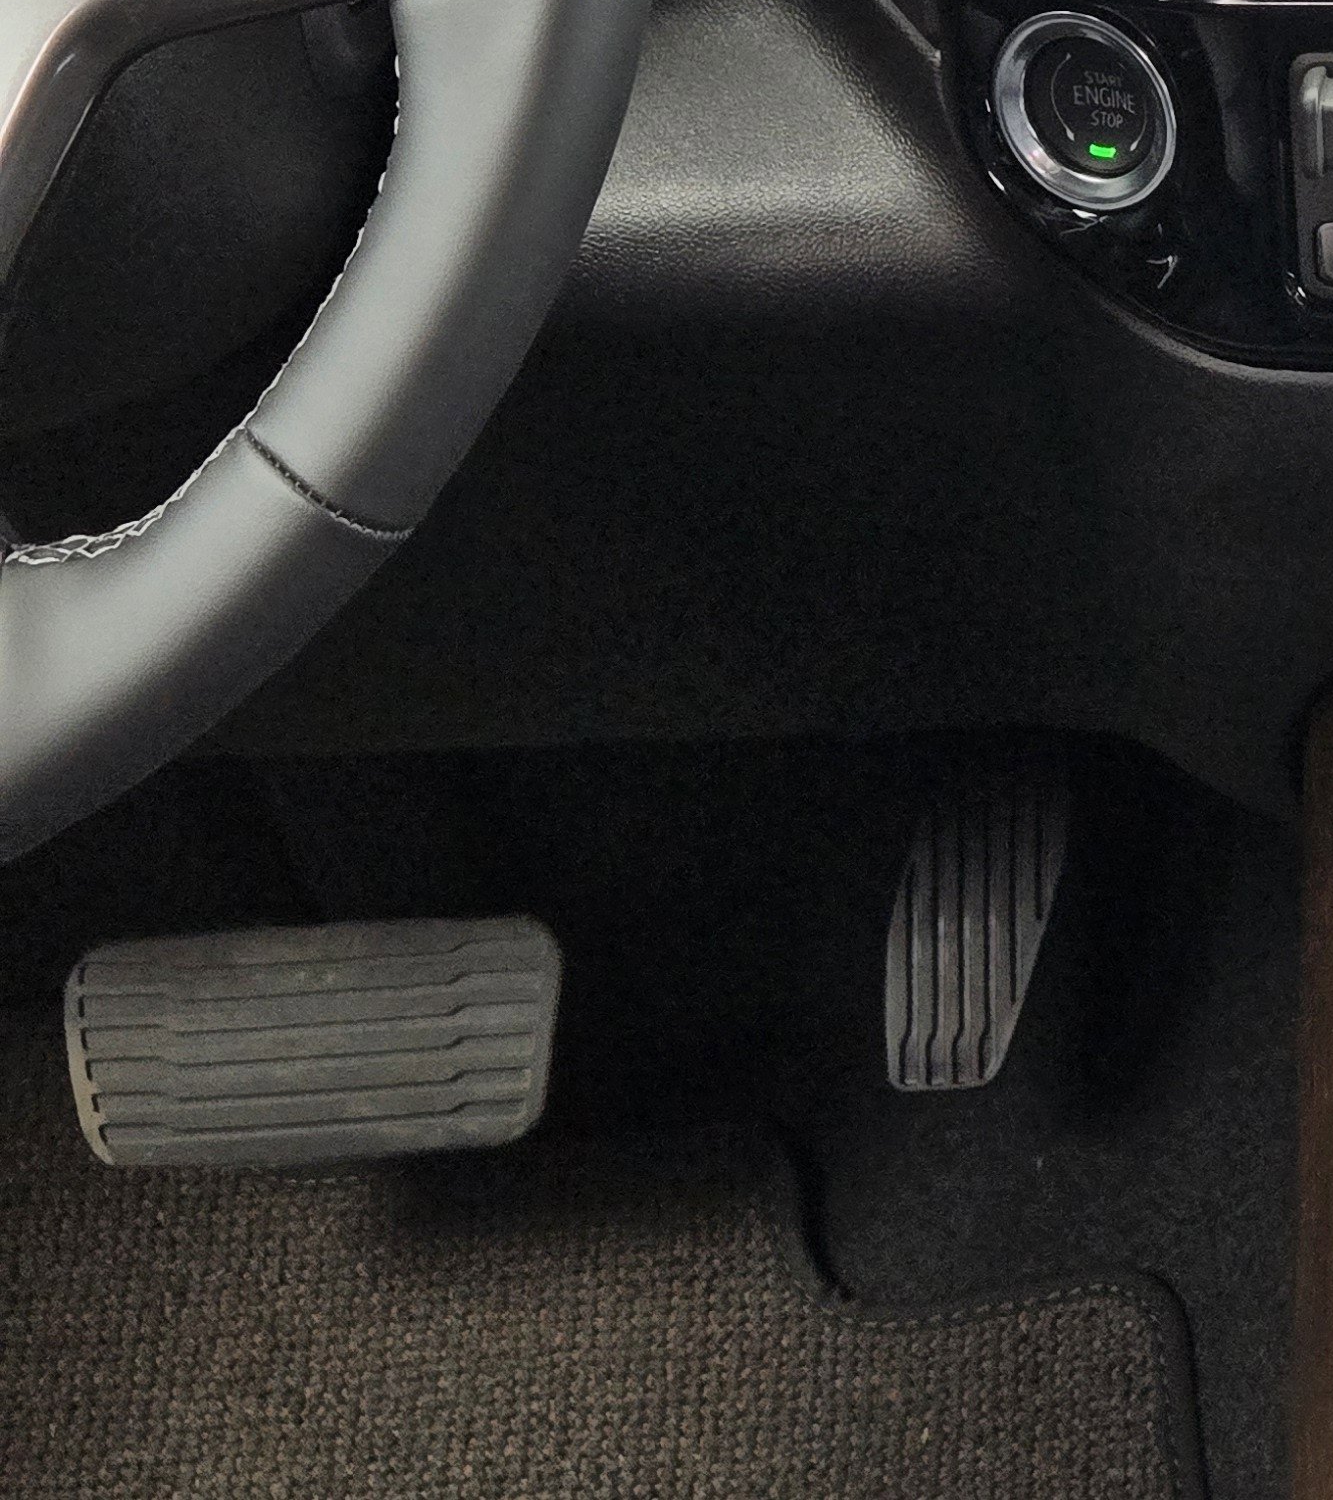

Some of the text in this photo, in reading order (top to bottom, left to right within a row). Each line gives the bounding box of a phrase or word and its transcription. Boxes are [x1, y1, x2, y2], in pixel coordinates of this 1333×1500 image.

[1083, 70, 1123, 87] START
[1072, 85, 1137, 115] ENGINE
[1090, 109, 1124, 128] STOP
